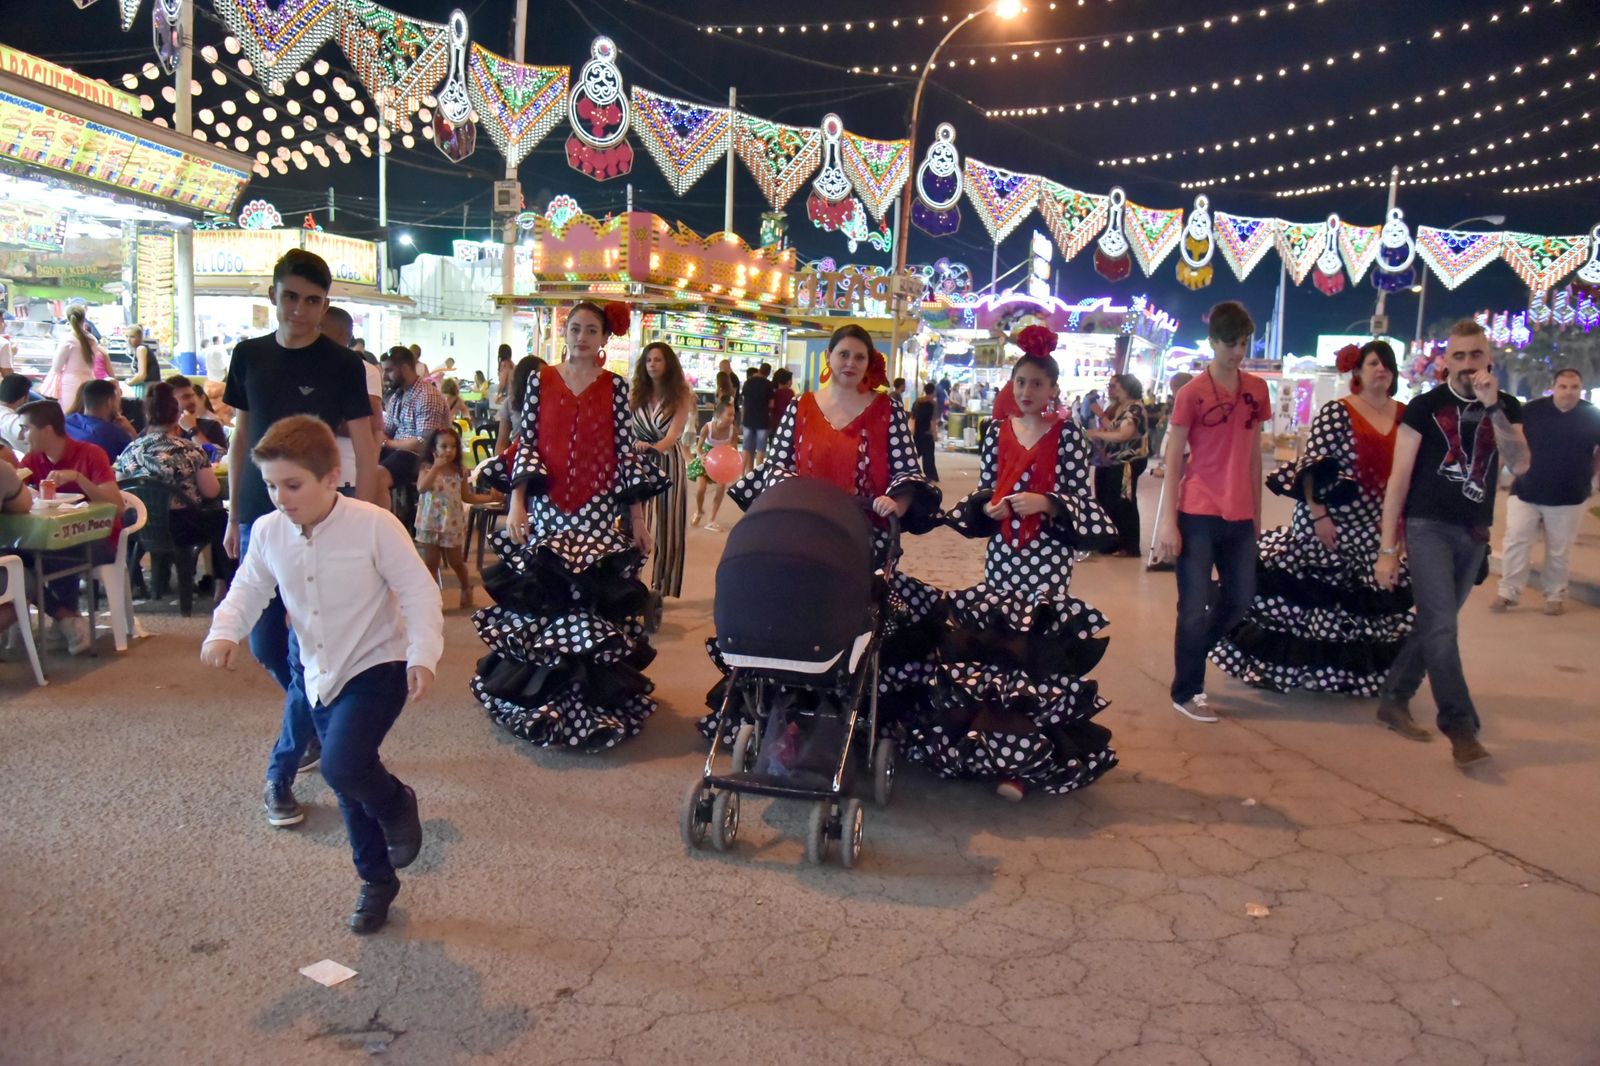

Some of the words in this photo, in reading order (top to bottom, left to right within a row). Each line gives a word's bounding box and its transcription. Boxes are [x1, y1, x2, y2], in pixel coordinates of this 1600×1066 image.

[58, 112, 85, 126] LOBO
[85, 121, 136, 143] BAGUETTERIA
[192, 156, 211, 168] LOBO
[211, 251, 244, 273] LOBO
[336, 263, 361, 281] LOBO
[677, 335, 685, 346] LA
